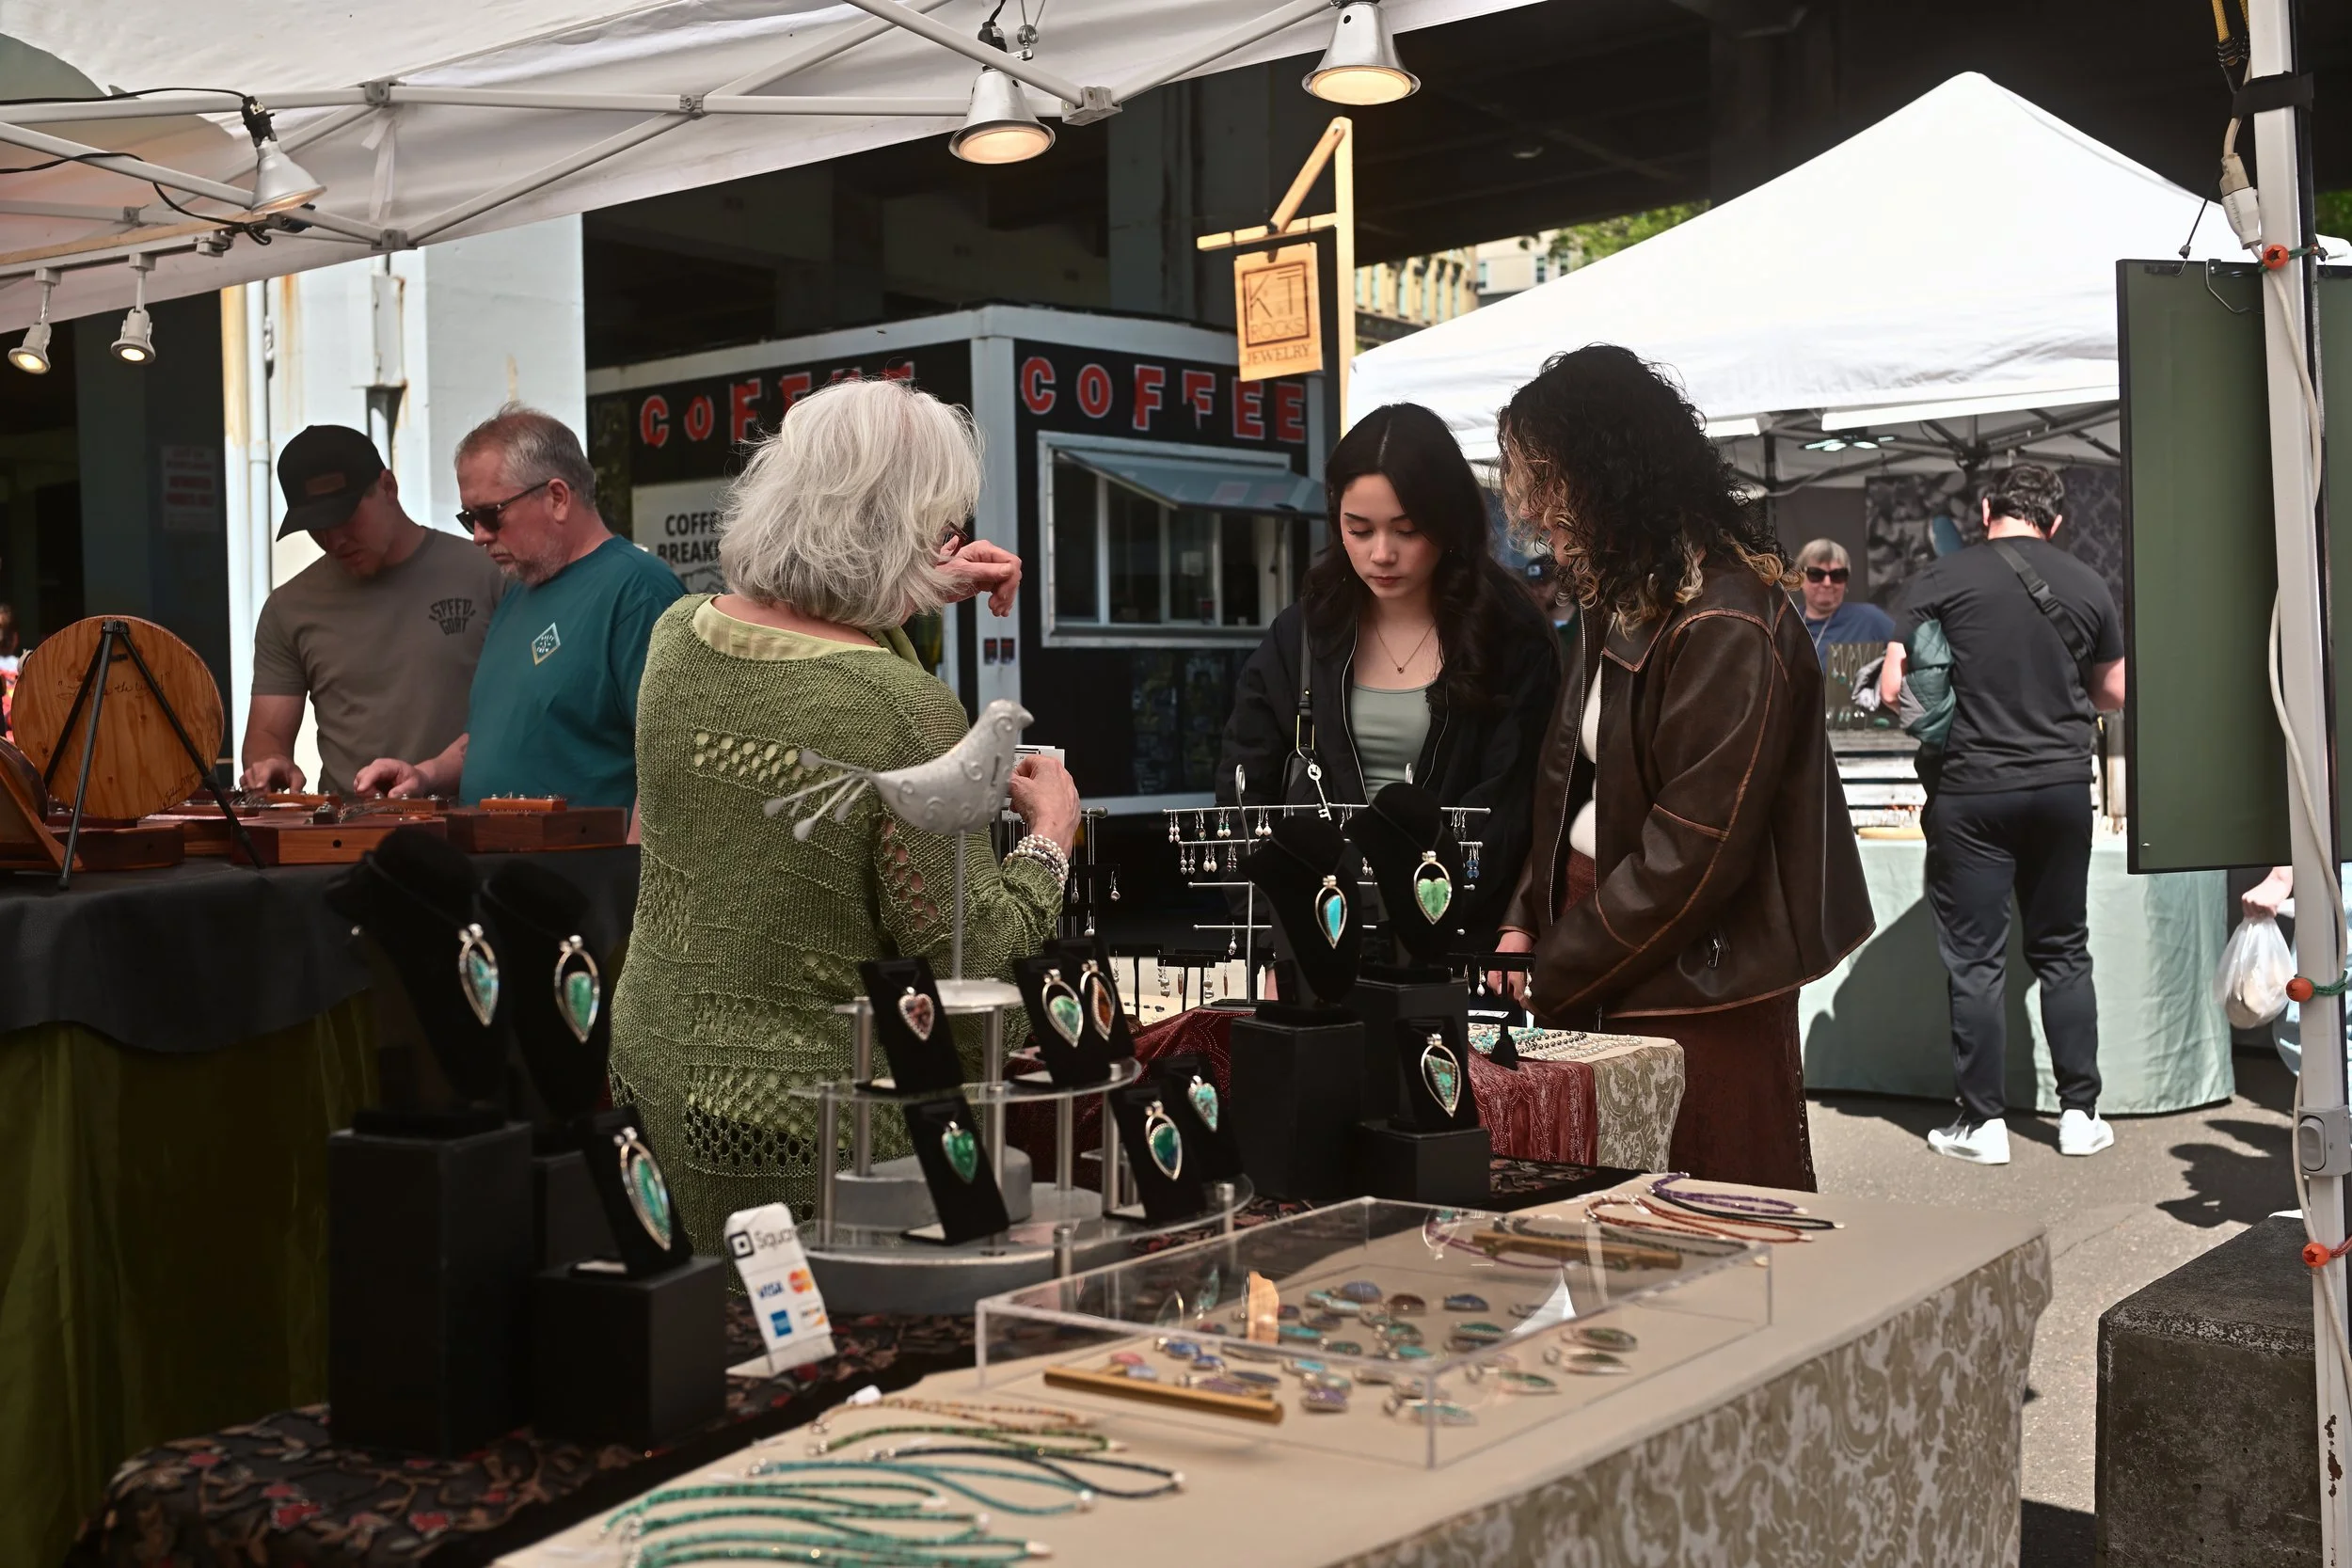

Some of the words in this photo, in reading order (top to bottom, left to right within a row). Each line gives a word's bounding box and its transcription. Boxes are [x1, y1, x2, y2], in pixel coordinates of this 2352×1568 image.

[1250, 317, 1306, 341] ROCKS
[1244, 343, 1311, 366] JEWELRY
[639, 361, 914, 448] COFF
[1020, 356, 1307, 443] COFFEE
[429, 598, 473, 619] SPEED
[756, 1280, 785, 1298] VISA
